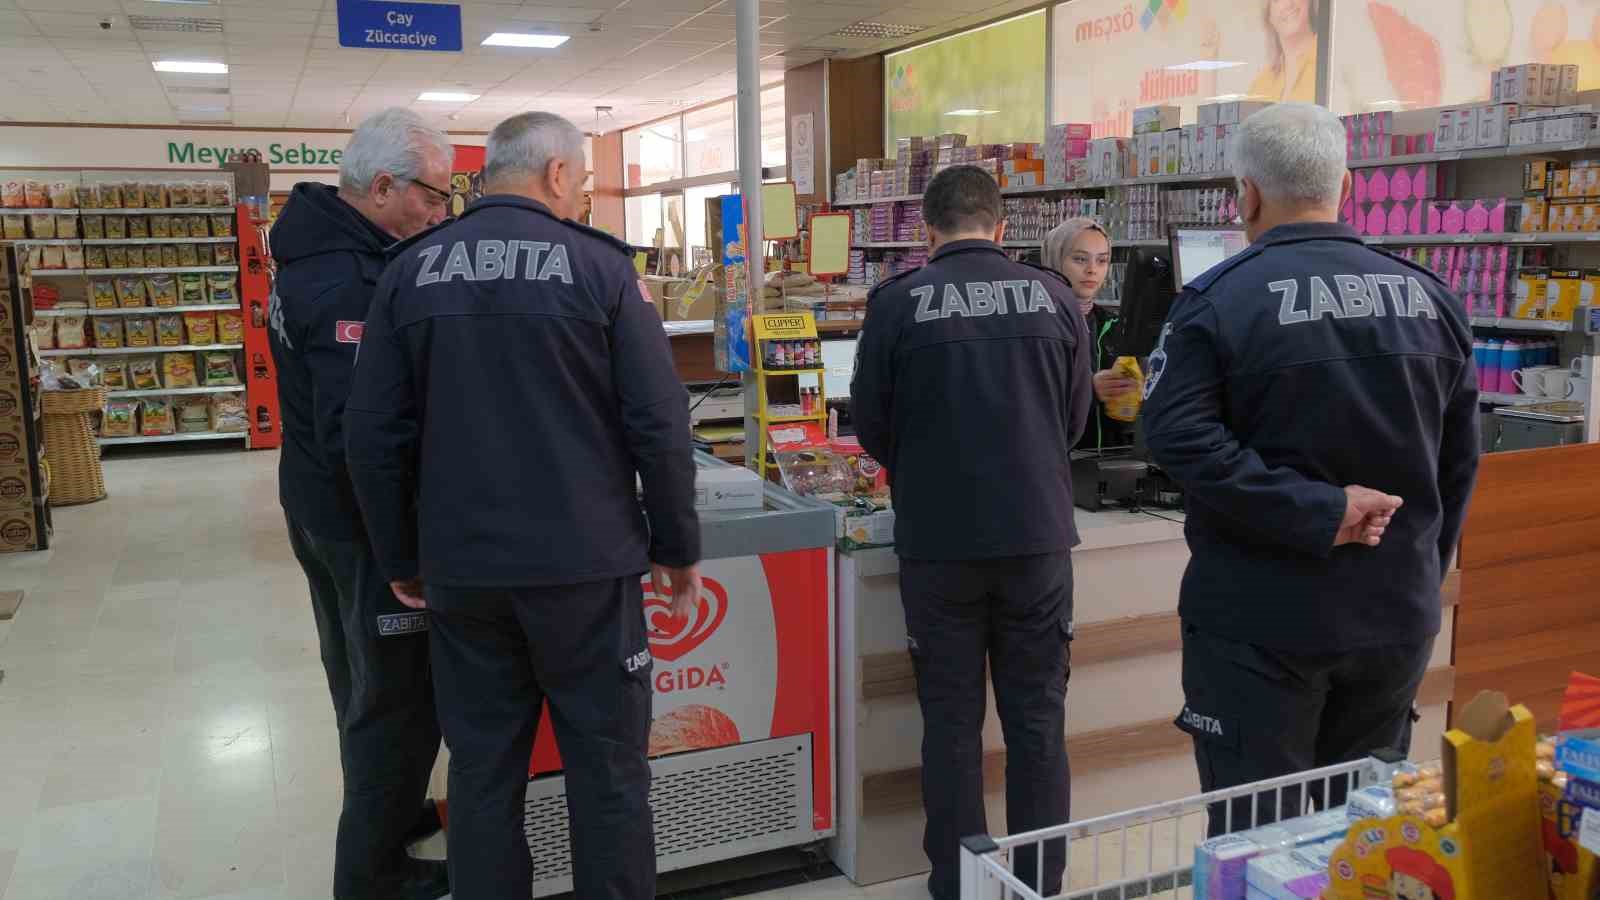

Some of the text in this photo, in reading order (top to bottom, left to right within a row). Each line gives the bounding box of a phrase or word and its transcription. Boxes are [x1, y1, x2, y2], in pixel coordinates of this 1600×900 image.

[386, 11, 414, 26] Çay
[365, 29, 437, 47] Züccaciye
[270, 143, 343, 164] Sebze
[415, 239, 574, 287] ZABITA
[909, 279, 1057, 323] ZABITA
[1267, 273, 1438, 326] ZABITA
